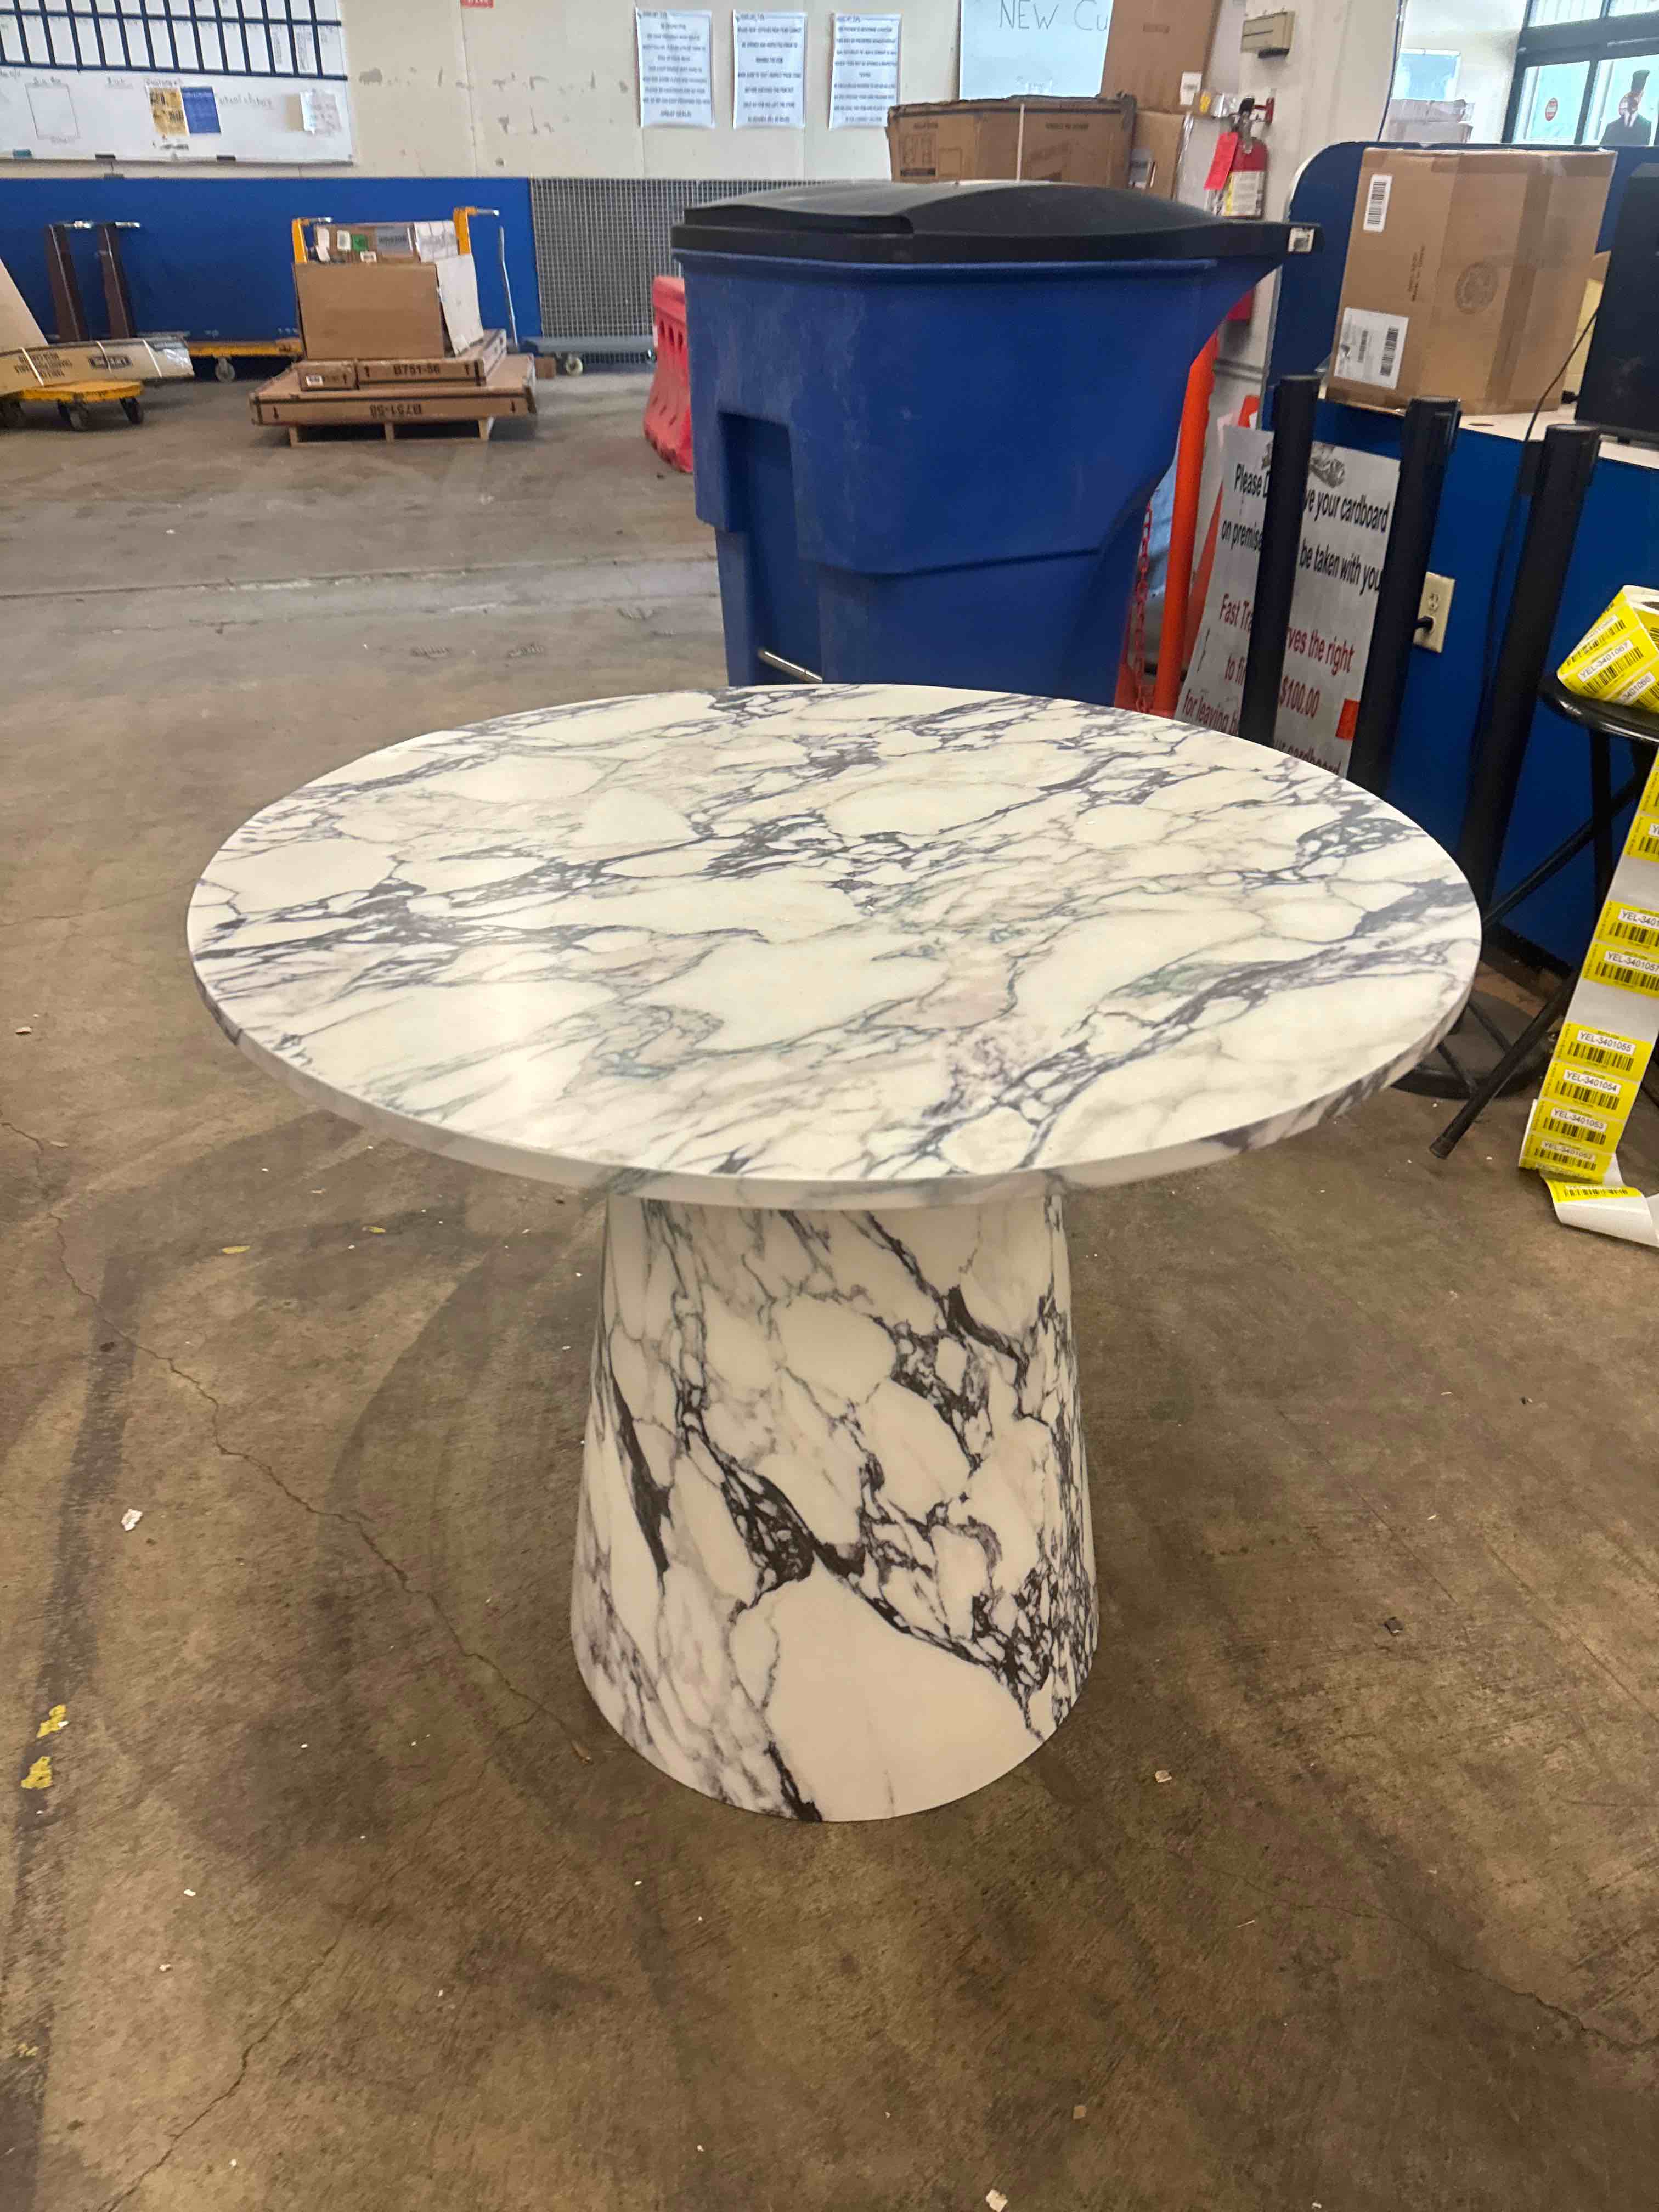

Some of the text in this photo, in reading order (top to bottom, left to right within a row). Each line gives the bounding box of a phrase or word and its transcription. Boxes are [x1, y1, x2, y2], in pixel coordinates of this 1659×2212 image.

[1000, 0, 1059, 30] NEW
[1234, 463, 1262, 498] Please
[1314, 491, 1341, 522] your
[1340, 494, 1390, 533] cardboard
[1221, 520, 1232, 540] on
[1299, 537, 1313, 569] be
[1313, 544, 1340, 578] taken
[1340, 552, 1361, 585] with
[1220, 593, 1240, 627] Fast
[1308, 629, 1325, 662] the
[1325, 636, 1355, 676] right
[1224, 653, 1235, 681] to
[1279, 675, 1321, 718] $100.00
[1621, 674, 1652, 702] 3401066
[1182, 689, 1197, 717] for
[1580, 1031, 1633, 1052] YEL-3401055
[1566, 1071, 1617, 1092] YEL-3401054
[1554, 1108, 1604, 1130] YEL-3401053
